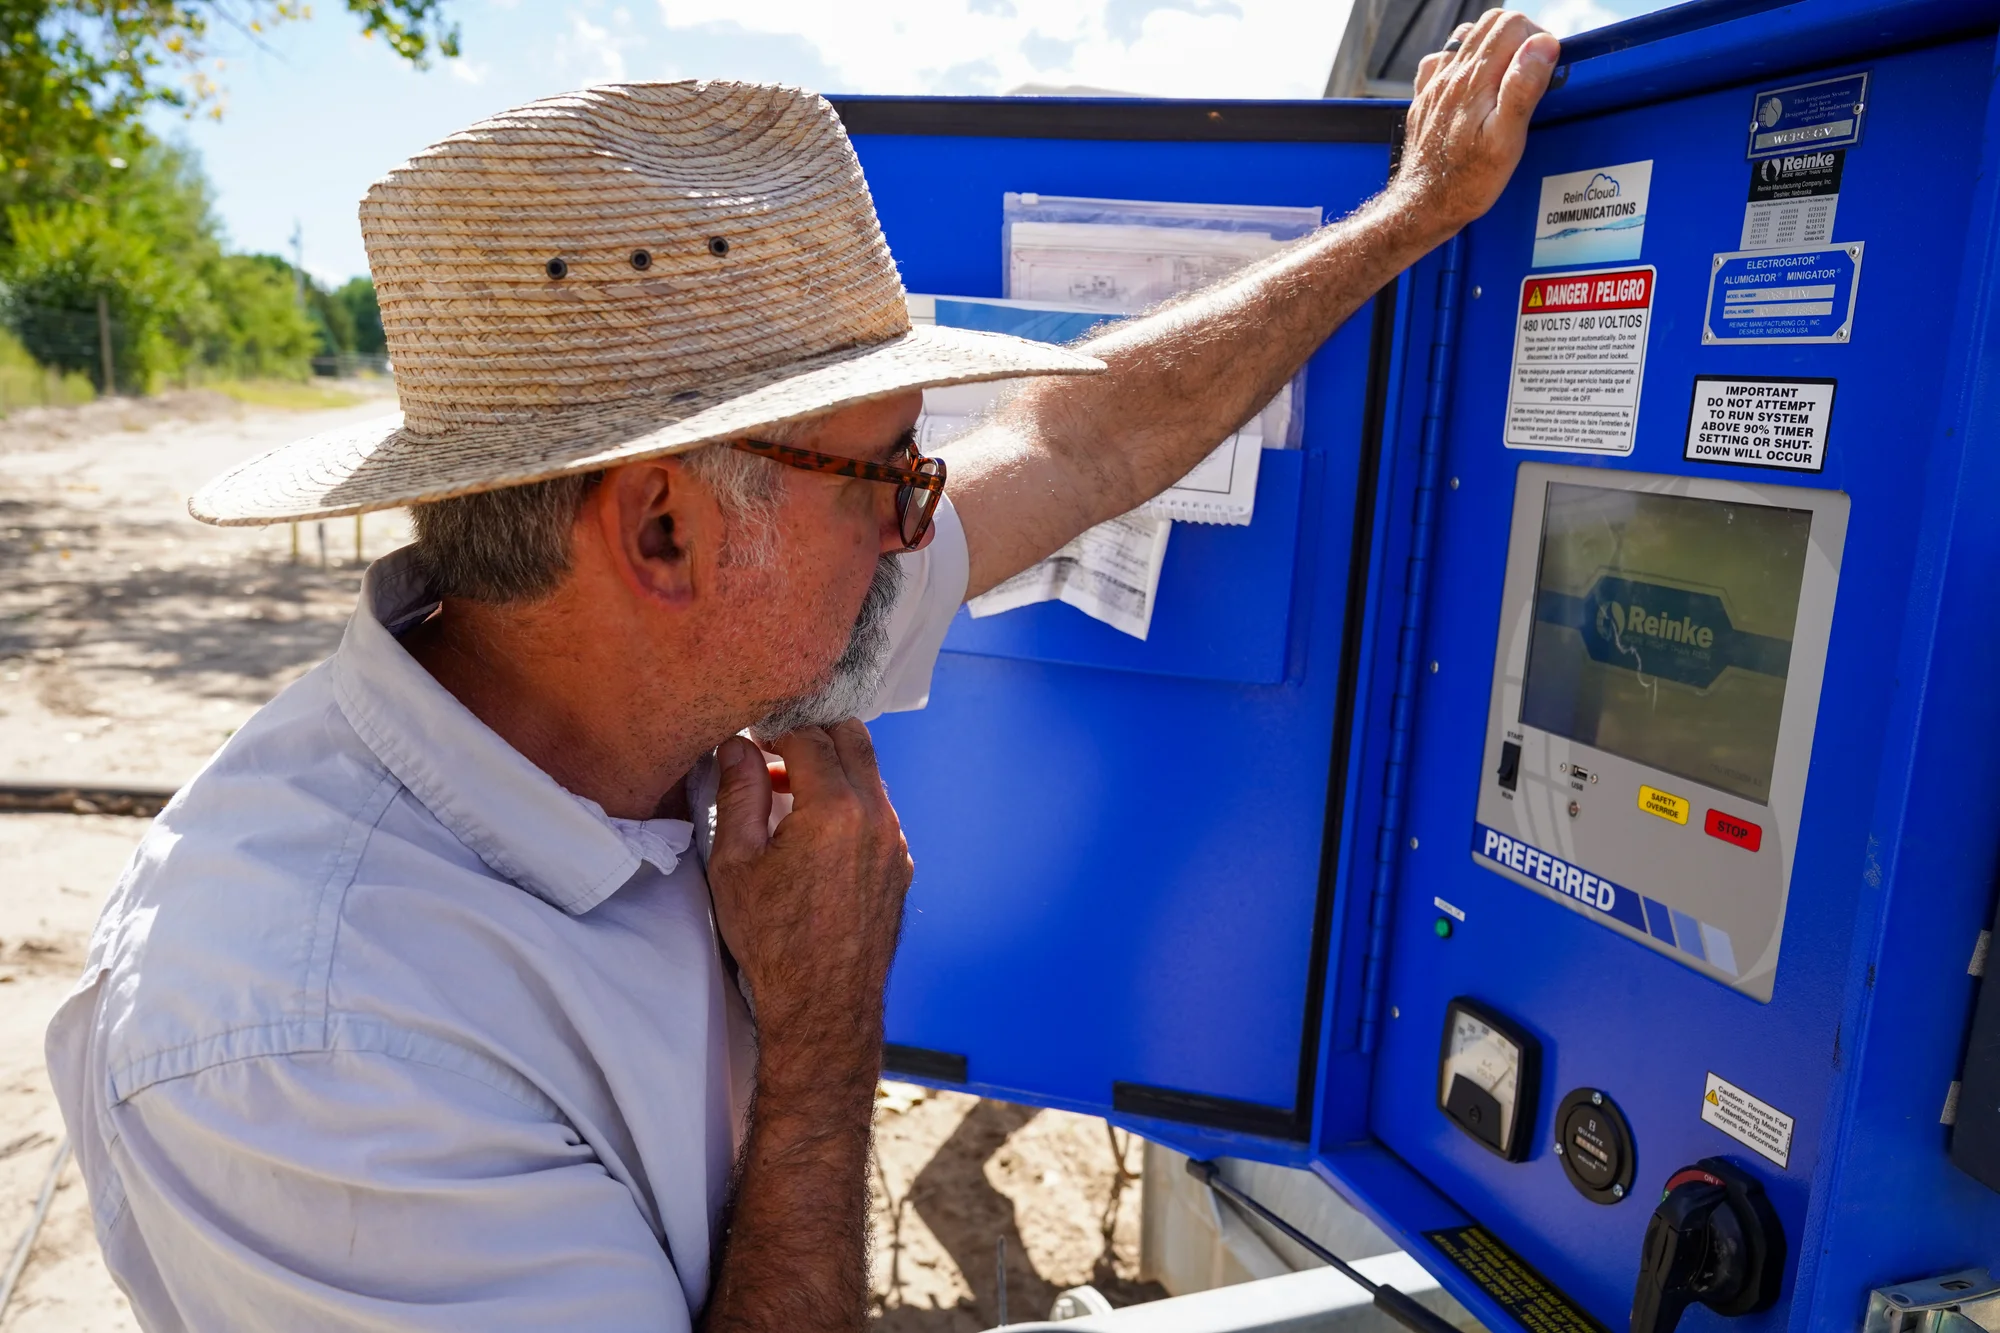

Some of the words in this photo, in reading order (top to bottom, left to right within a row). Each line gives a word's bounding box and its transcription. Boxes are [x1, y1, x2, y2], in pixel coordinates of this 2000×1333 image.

[1783, 152, 1834, 171] Reinke
[1772, 182, 1801, 190] Manufacturing
[1547, 202, 1636, 224] COMMUNICATIONS
[1545, 282, 1589, 306] DANGER
[1596, 278, 1645, 303] PELIGRO
[1523, 320, 1538, 332] 480
[1541, 318, 1571, 331] VOLTS
[1579, 317, 1595, 330] 480
[1598, 314, 1643, 329] VOLTIOS
[1525, 335, 1535, 343] This
[1557, 336, 1567, 344] may
[1618, 333, 1626, 341] Do
[1726, 386, 1798, 398] IMPORTANT
[1707, 398, 1723, 407] DO
[1727, 399, 1752, 408] NOT
[1756, 400, 1816, 411] ATTEMPT
[1710, 410, 1724, 419] TO
[1728, 411, 1754, 421] RUN
[1758, 412, 1809, 424] SYSTEM
[1701, 422, 1740, 432] ABOVE
[1744, 424, 1770, 434] 90%
[1774, 426, 1814, 437] TIMER
[1699, 433, 1749, 445] SETTING
[1753, 437, 1770, 447] OR
[1774, 438, 1812, 450] SHUT-
[1696, 445, 1730, 456] DOWN
[1734, 448, 1762, 459] WILL
[1766, 450, 1812, 463] OCCUR
[1627, 605, 1713, 648] Reinke
[1507, 731, 1523, 741] START
[1571, 781, 1583, 791] USB
[1502, 791, 1513, 800] RUN
[1651, 793, 1676, 807] SAFETY
[1646, 801, 1679, 819] OVERRIDE
[1717, 820, 1748, 839] STOP
[1484, 829, 1615, 911] PREFERRED
[1718, 1085, 1745, 1105] Caution:
[1748, 1102, 1773, 1122] Reverse
[1775, 1117, 1788, 1130] Fed
[1719, 1095, 1760, 1124] Disconnecting
[1762, 1119, 1784, 1138] Means.
[1720, 1106, 1752, 1128] Attention:
[1753, 1124, 1779, 1144] Reverse
[1577, 1126, 1604, 1147] QUARTZ
[1714, 1111, 1737, 1130] moyens
[1739, 1126, 1746, 1134] de
[1747, 1130, 1786, 1158] déconnexion
[1704, 1174, 1714, 1184] ON
[1513, 1280, 1538, 1299] LOAD
[1551, 1313, 1568, 1324] OF
[1540, 1292, 1562, 1306] AND
